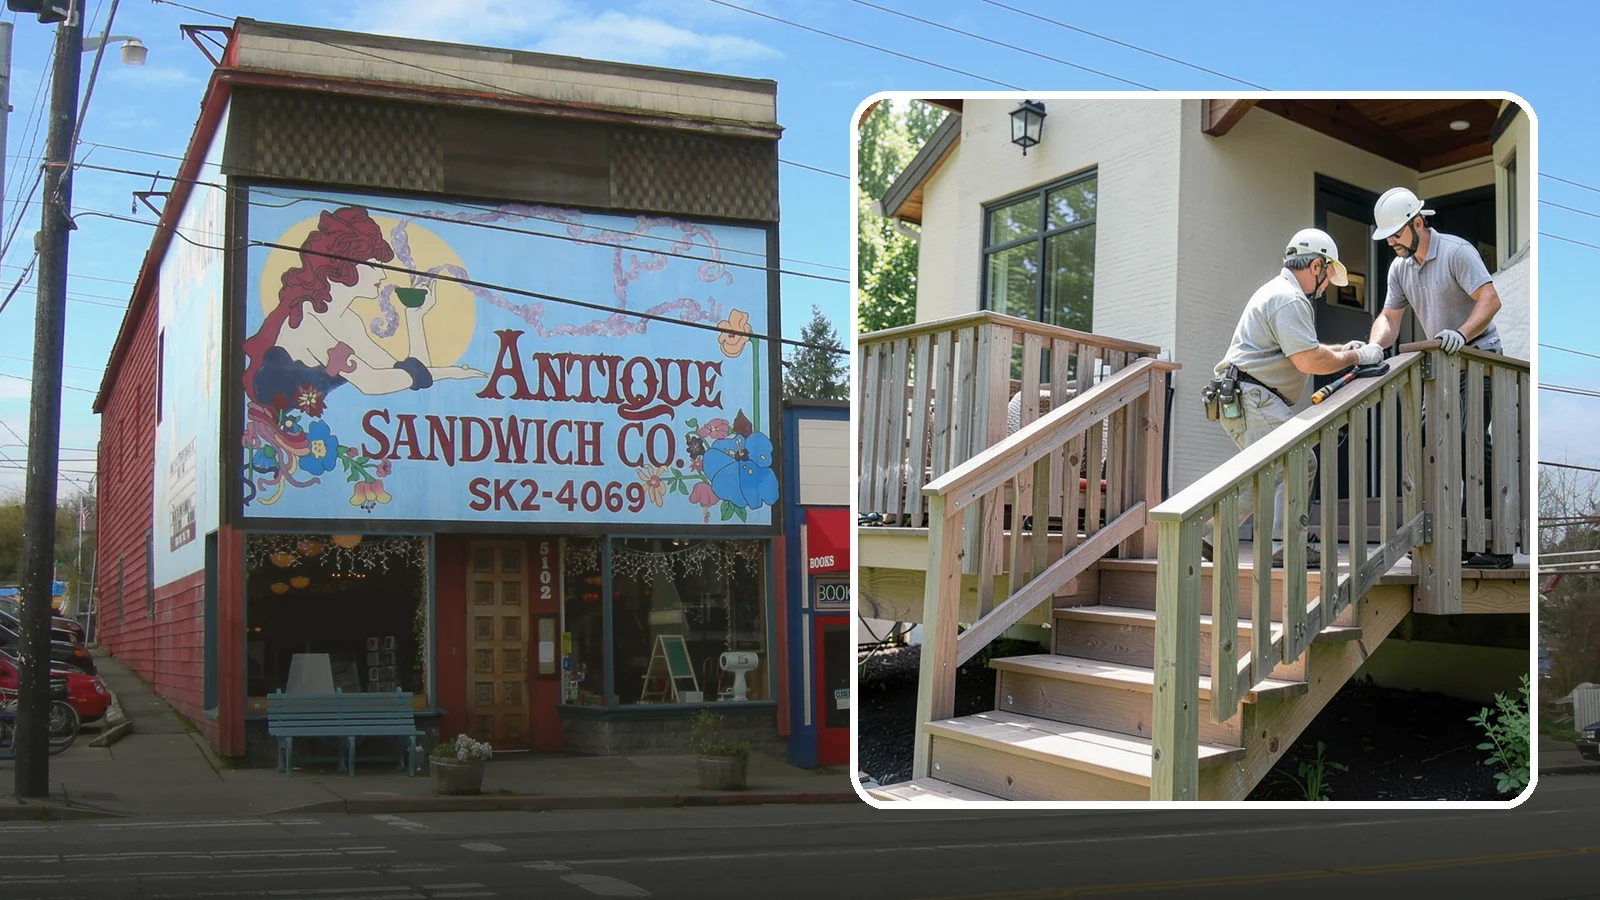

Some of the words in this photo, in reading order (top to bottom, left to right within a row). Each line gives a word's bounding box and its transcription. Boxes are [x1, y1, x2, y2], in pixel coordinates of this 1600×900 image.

[476, 329, 723, 420] ANTIQUE
[361, 408, 604, 469] SANDWICH
[616, 421, 685, 470] CO.
[468, 477, 646, 512] SK2-4069
[540, 542, 552, 600] 5102
[809, 555, 835, 569] BOOKS
